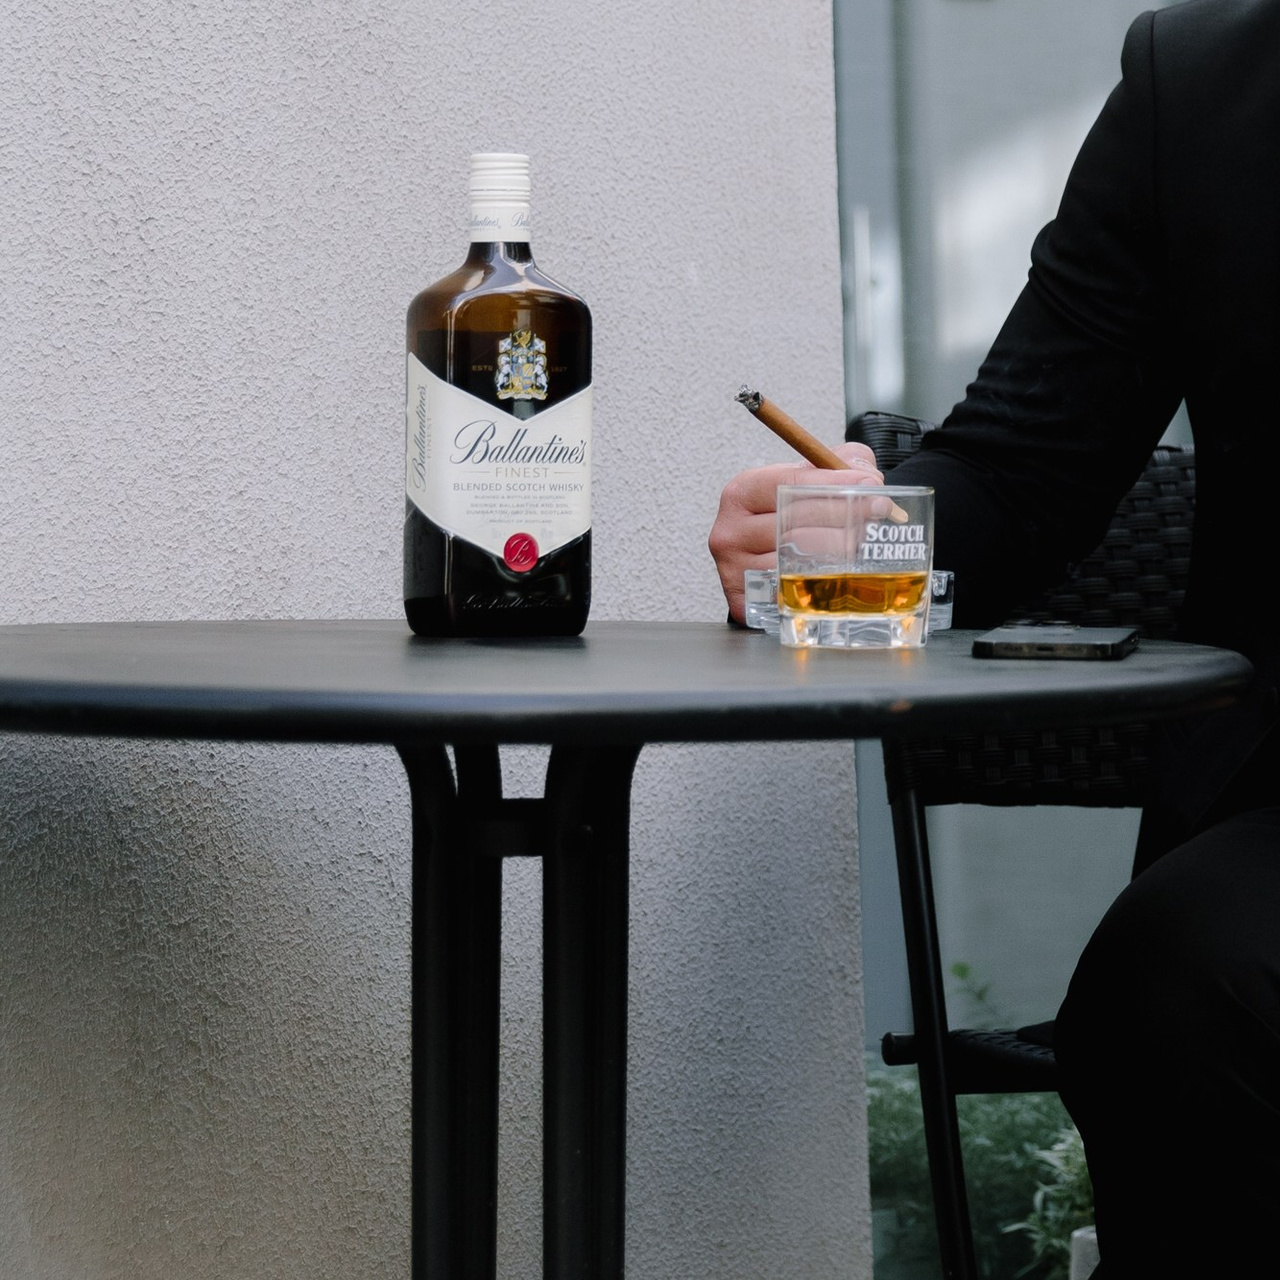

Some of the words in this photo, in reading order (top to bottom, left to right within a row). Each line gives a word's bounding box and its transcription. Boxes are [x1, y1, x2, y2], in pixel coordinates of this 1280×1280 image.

[450, 420, 586, 464] Ballantine's
[495, 467, 550, 478] FINEST
[453, 483, 502, 491] BLENDED
[506, 483, 545, 491] SCOTCH
[549, 483, 584, 491] WHISKY
[866, 523, 924, 542] SCOTCH
[861, 542, 926, 560] TERRIER
